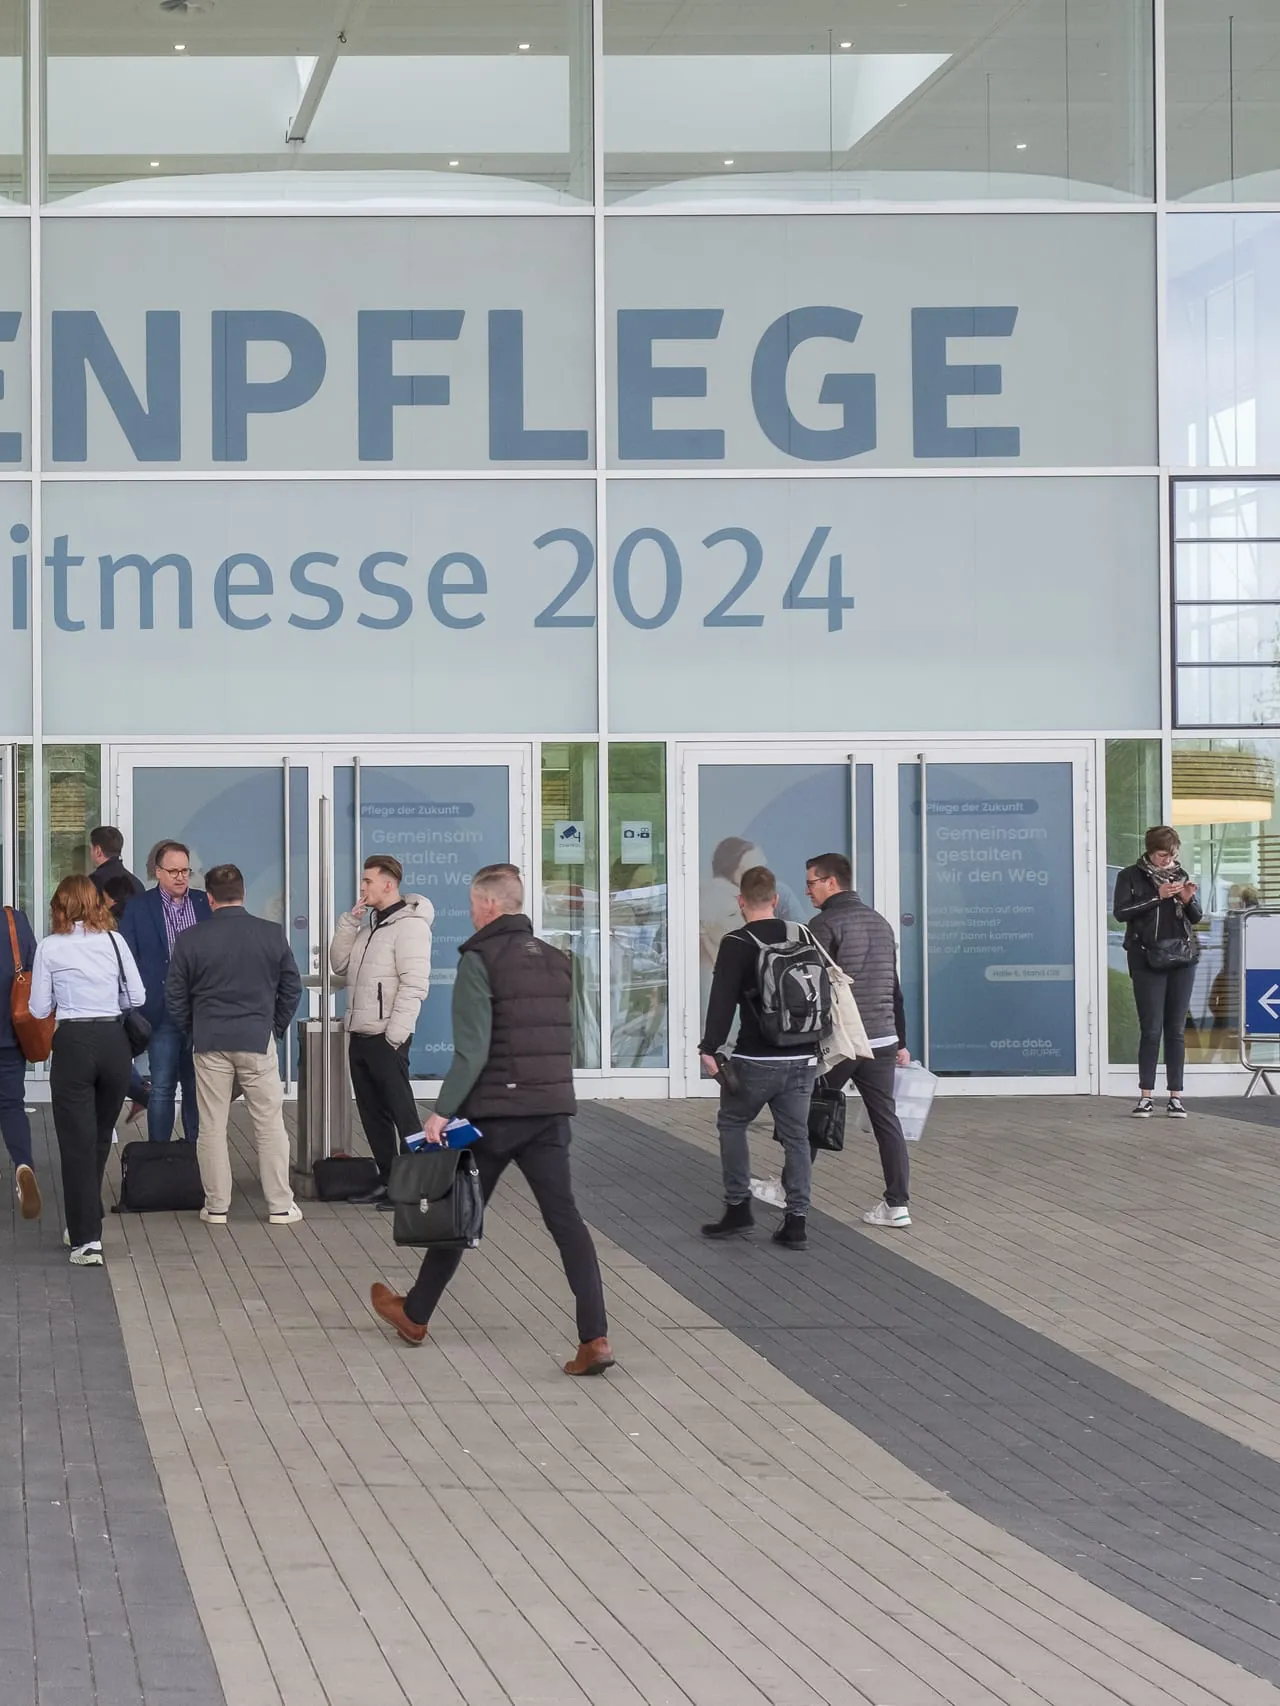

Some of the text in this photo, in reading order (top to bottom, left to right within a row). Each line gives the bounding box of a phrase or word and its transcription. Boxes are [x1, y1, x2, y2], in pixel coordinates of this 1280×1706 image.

[533, 525, 855, 633] 2024
[371, 828, 484, 844] Gemeinsam
[935, 826, 1048, 841] Gemeinsam
[936, 847, 1022, 866] gestalten
[444, 871, 471, 886] We
[968, 868, 1003, 883] den
[1008, 868, 1049, 886] Weg
